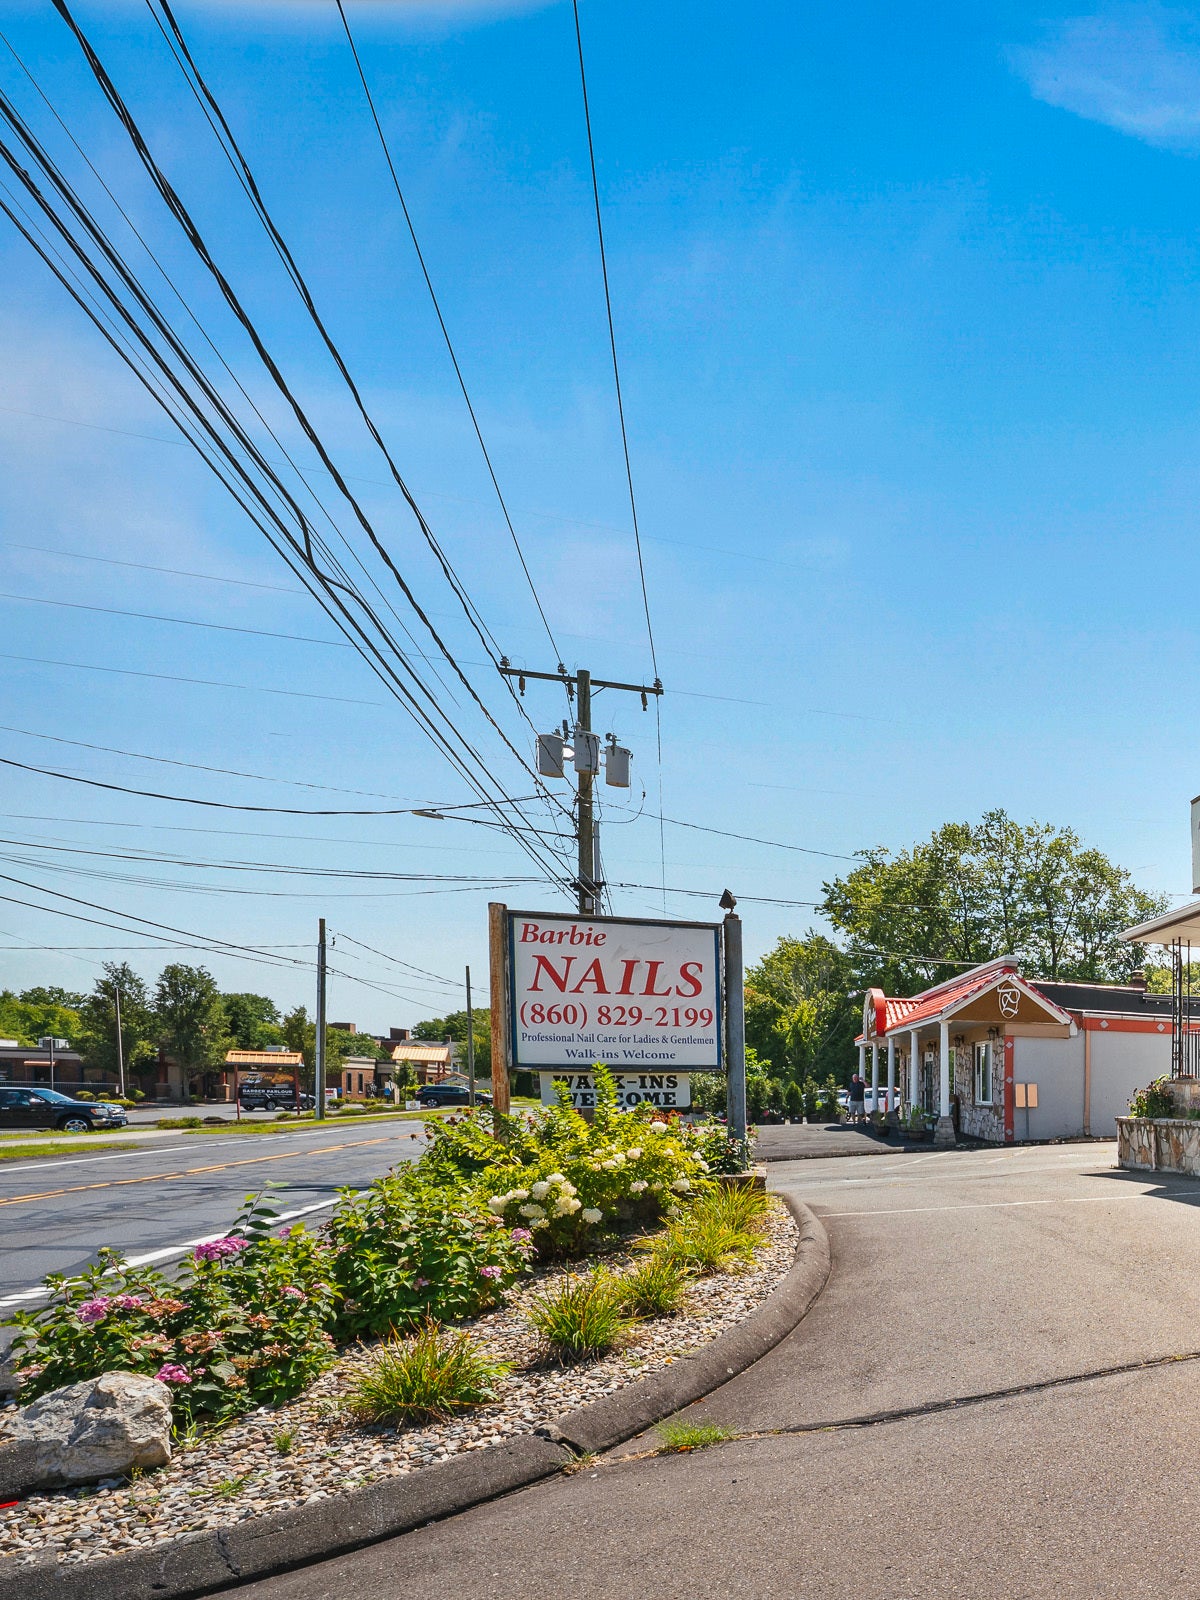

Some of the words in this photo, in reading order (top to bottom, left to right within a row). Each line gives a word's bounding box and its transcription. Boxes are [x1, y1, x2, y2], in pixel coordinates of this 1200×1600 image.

[518, 922, 607, 946] Barbie
[526, 954, 703, 998] NAILS
[519, 1001, 588, 1030] (860)
[597, 1005, 714, 1028] 829-2199
[521, 1032, 575, 1043] Professional
[576, 1033, 595, 1043] Nail
[596, 1034, 617, 1043] Care
[618, 1034, 631, 1043] for
[633, 1034, 660, 1044] Ladies
[661, 1035, 669, 1044] &
[670, 1034, 715, 1045] Gentlemen
[565, 1049, 619, 1059] Walk-ins
[622, 1049, 676, 1060] Welcome
